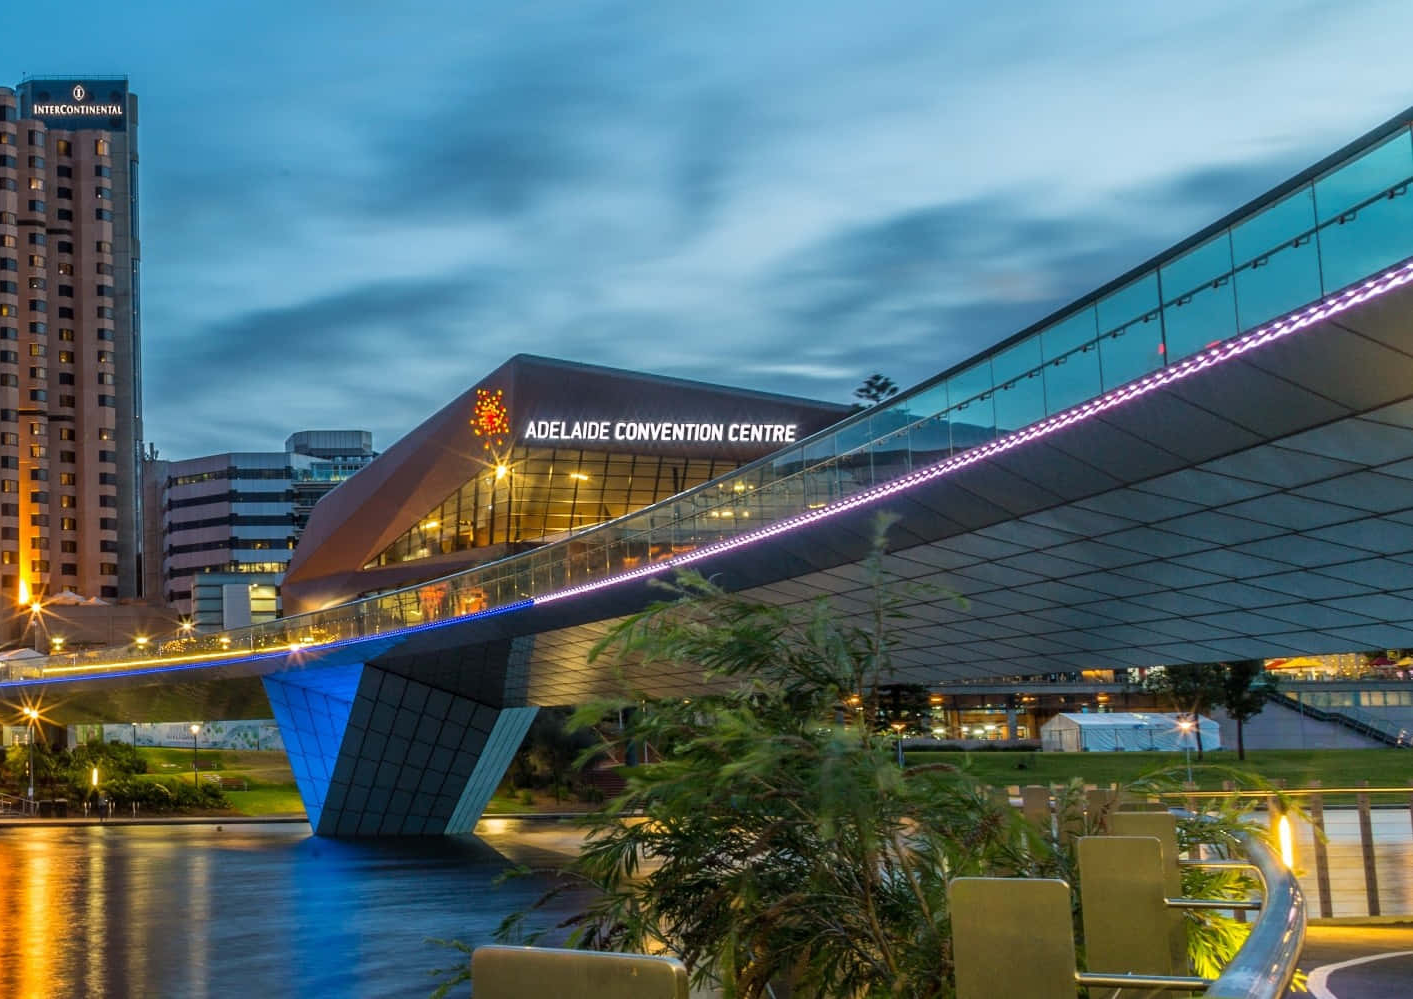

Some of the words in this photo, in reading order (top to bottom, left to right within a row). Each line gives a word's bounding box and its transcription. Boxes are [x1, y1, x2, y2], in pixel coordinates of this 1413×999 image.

[525, 421, 610, 440] ADELAIDE
[614, 422, 722, 441] CONVENTION
[728, 423, 797, 442] CENTRE
